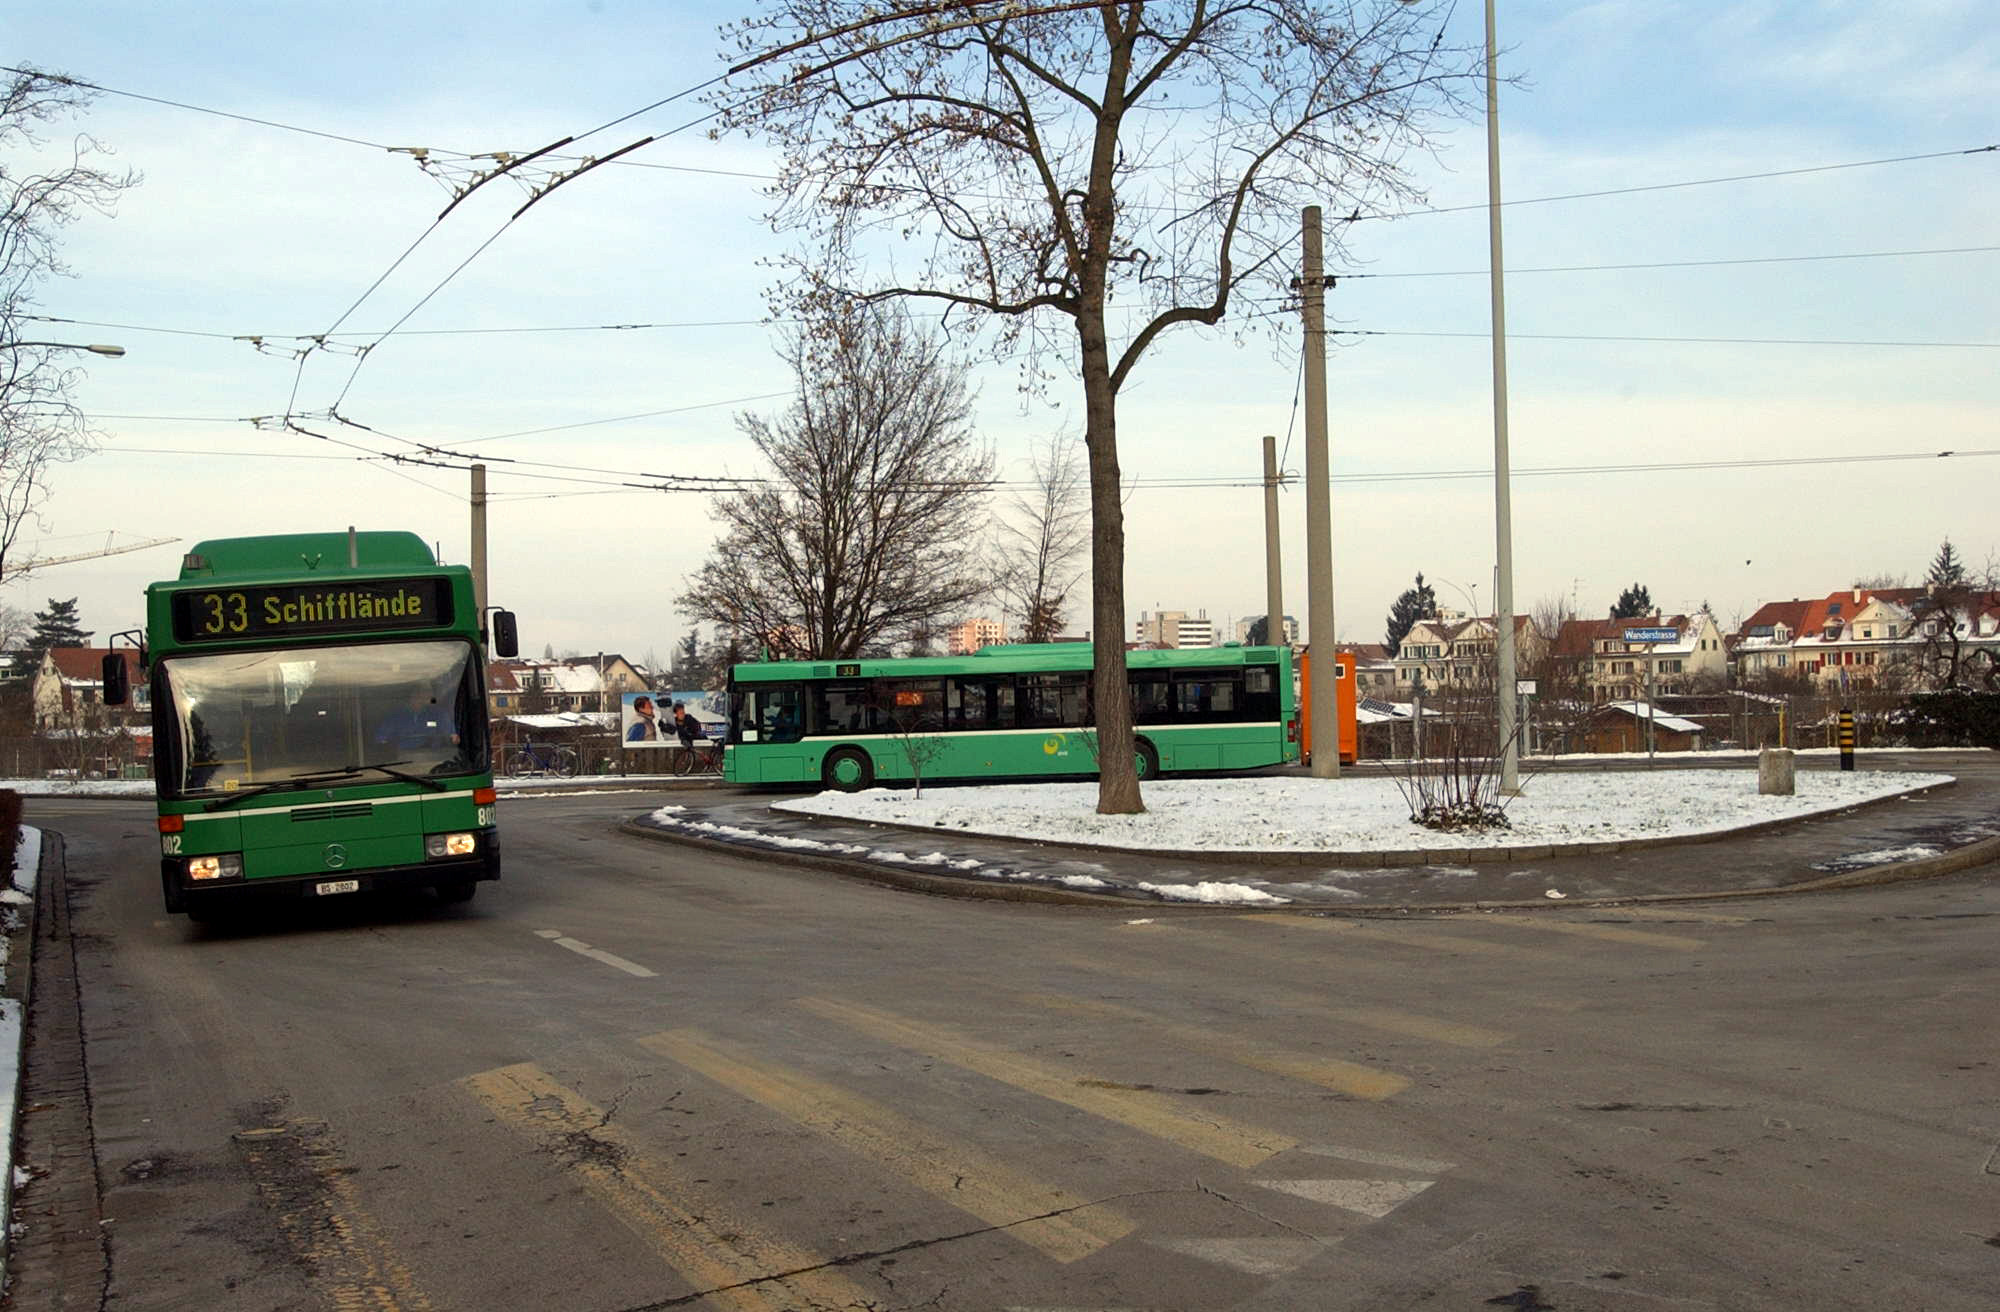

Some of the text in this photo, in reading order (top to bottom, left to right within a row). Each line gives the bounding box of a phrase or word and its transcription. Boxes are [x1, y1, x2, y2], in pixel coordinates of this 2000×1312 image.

[204, 589, 422, 633] 33 Schifflände
[1625, 630, 1677, 641] Wanderstrasse
